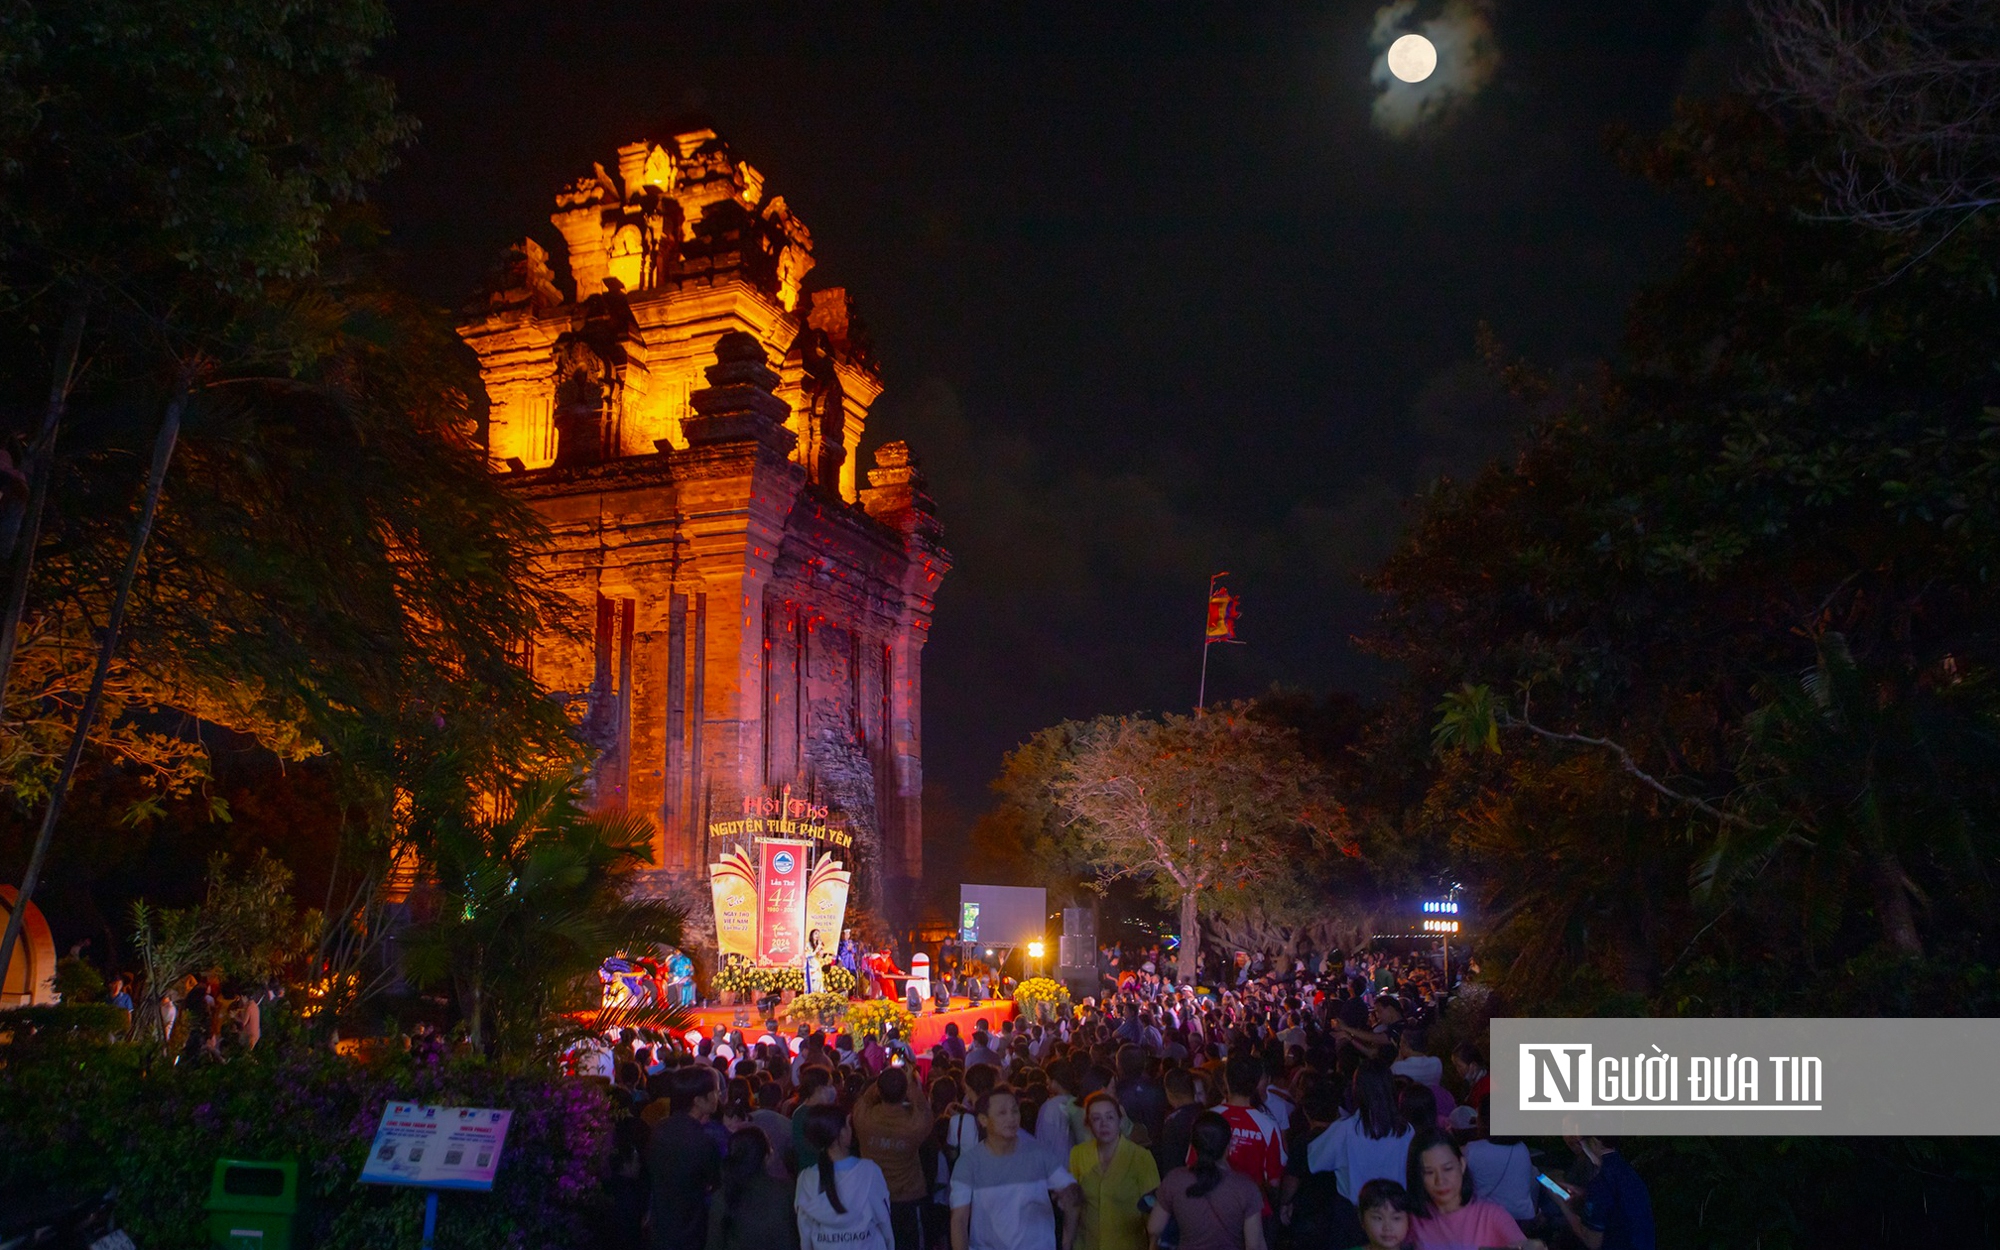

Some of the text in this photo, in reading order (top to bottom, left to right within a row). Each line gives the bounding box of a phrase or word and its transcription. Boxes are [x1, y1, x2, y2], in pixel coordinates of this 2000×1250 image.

[788, 797, 829, 820] Thơ
[800, 824, 826, 838] PHÚ
[829, 829, 853, 849] YÊN
[768, 887, 796, 907] 44
[772, 938, 790, 947] 2024
[817, 1230, 871, 1243] BALENCIAGA
